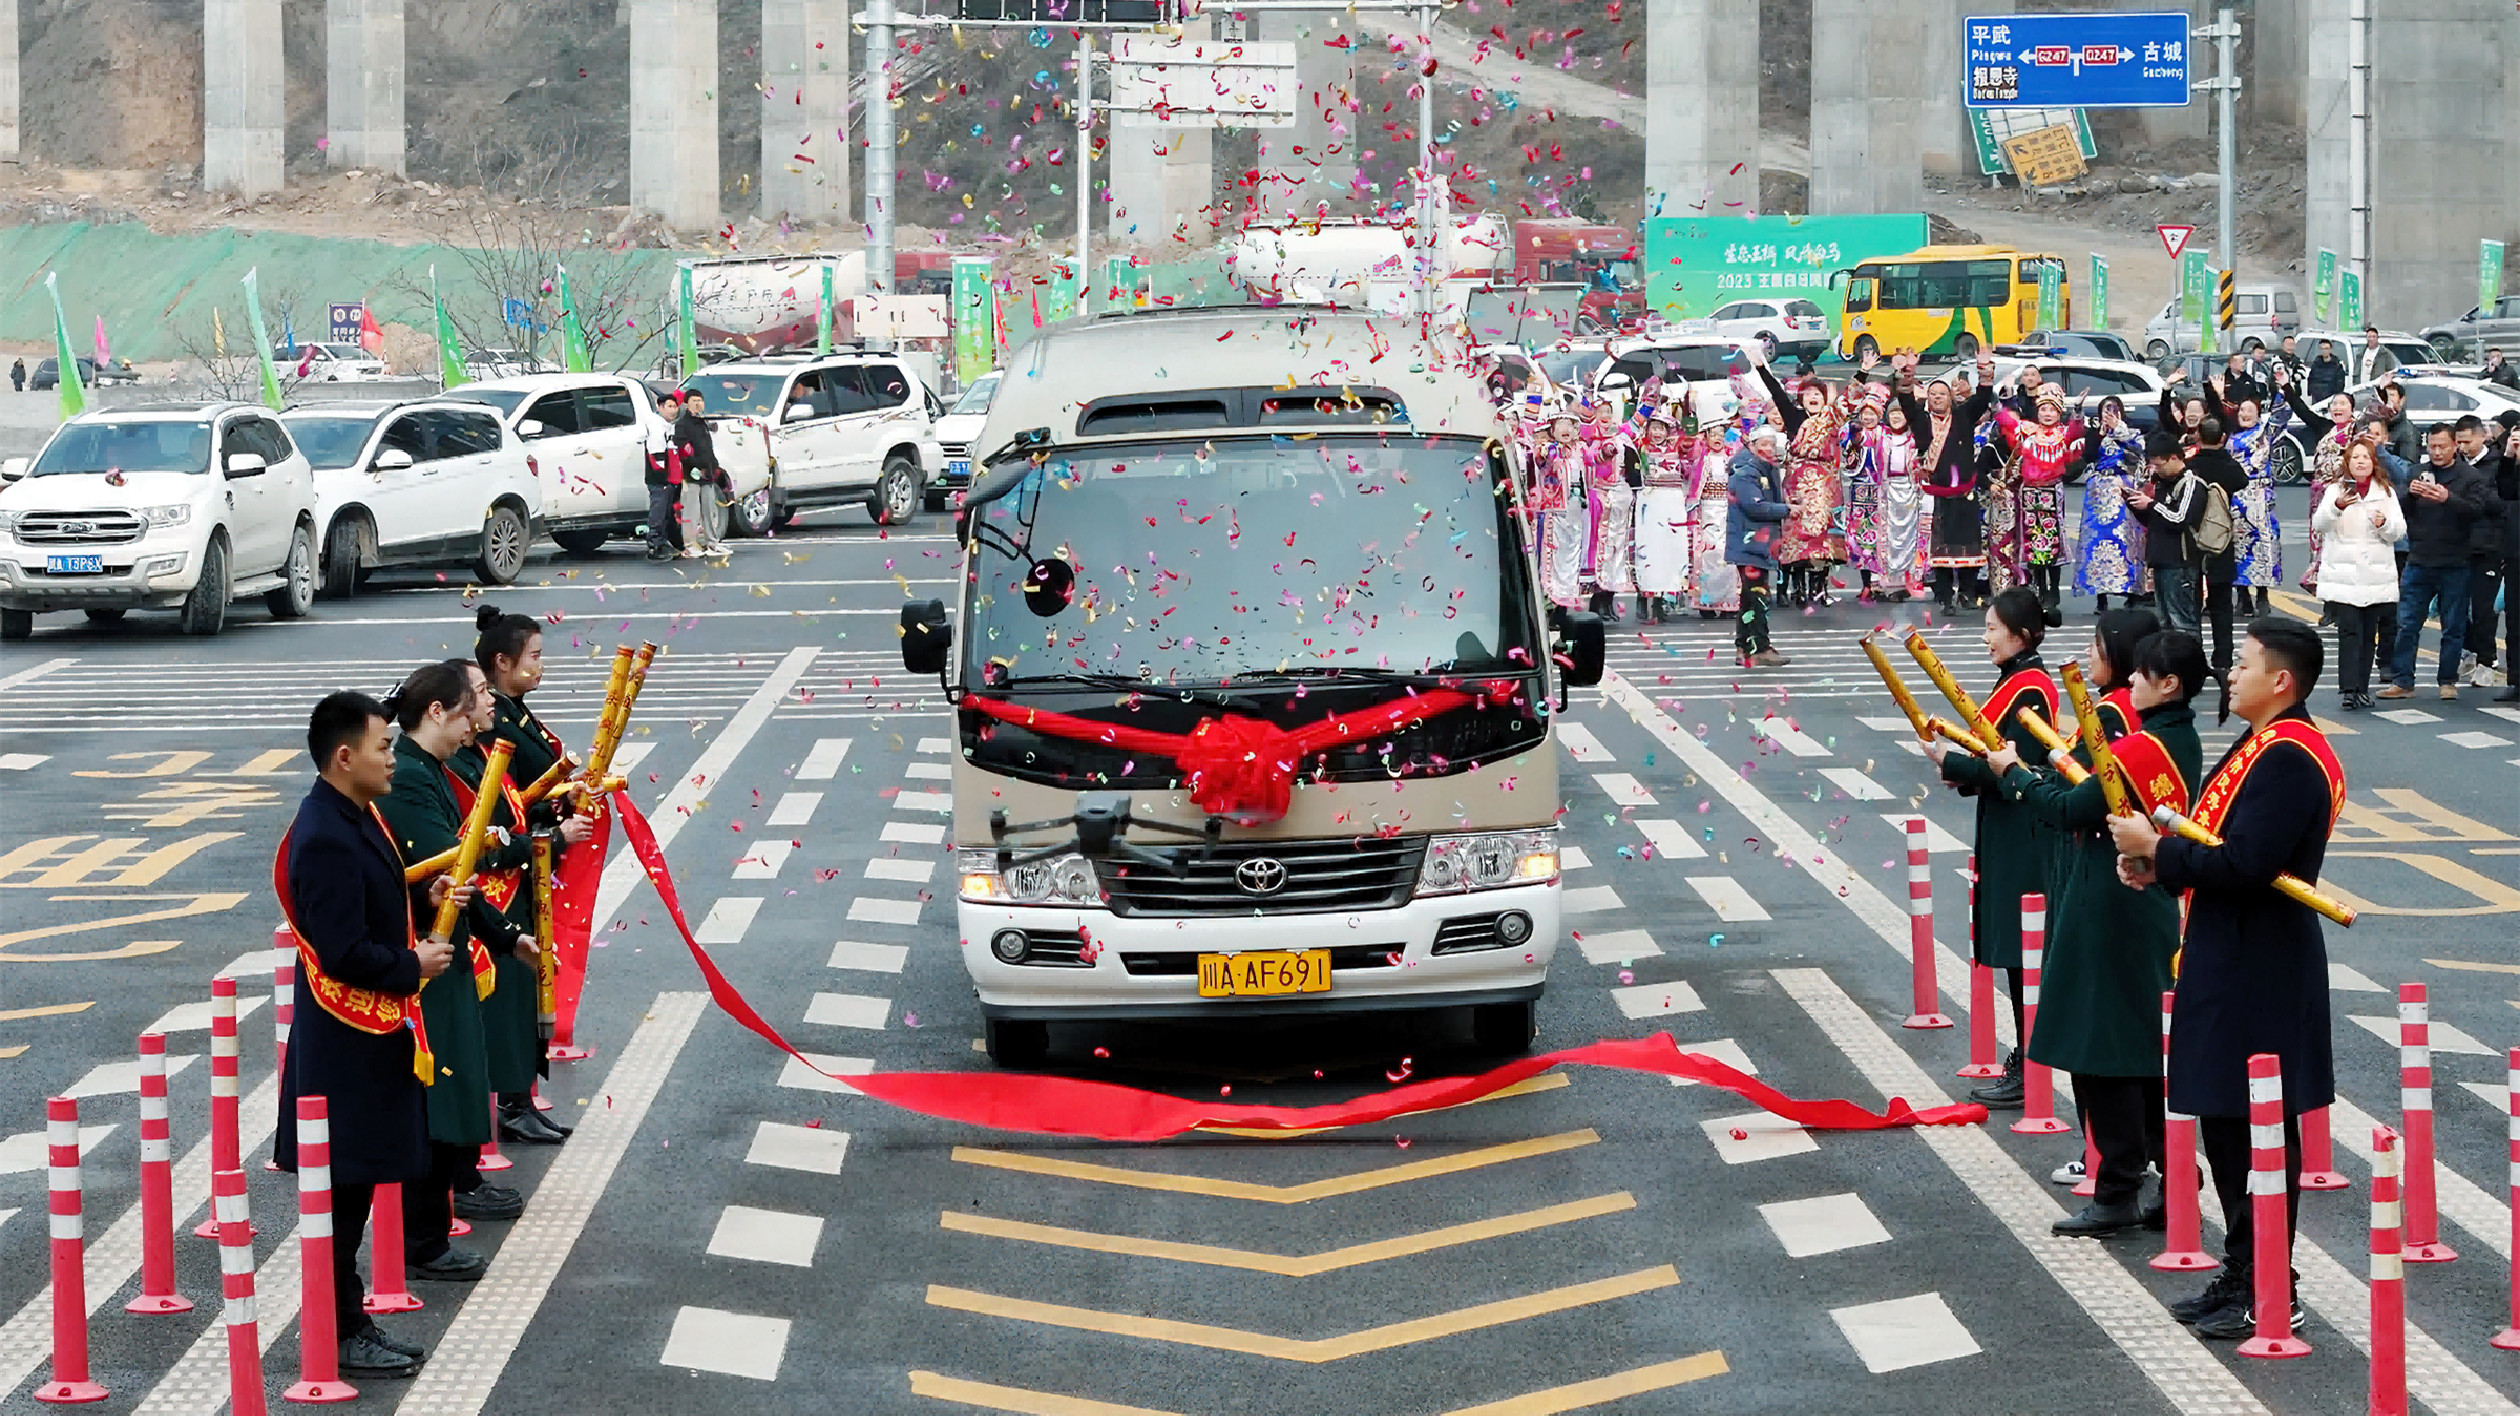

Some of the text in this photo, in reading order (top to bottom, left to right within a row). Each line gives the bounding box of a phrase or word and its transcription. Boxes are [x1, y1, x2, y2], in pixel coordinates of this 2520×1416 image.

[1972, 25, 2011, 45] 平武
[2143, 41, 2183, 62] 古城
[1717, 273, 1751, 289] 2023
[1203, 957, 1323, 989] 川A·AF691
